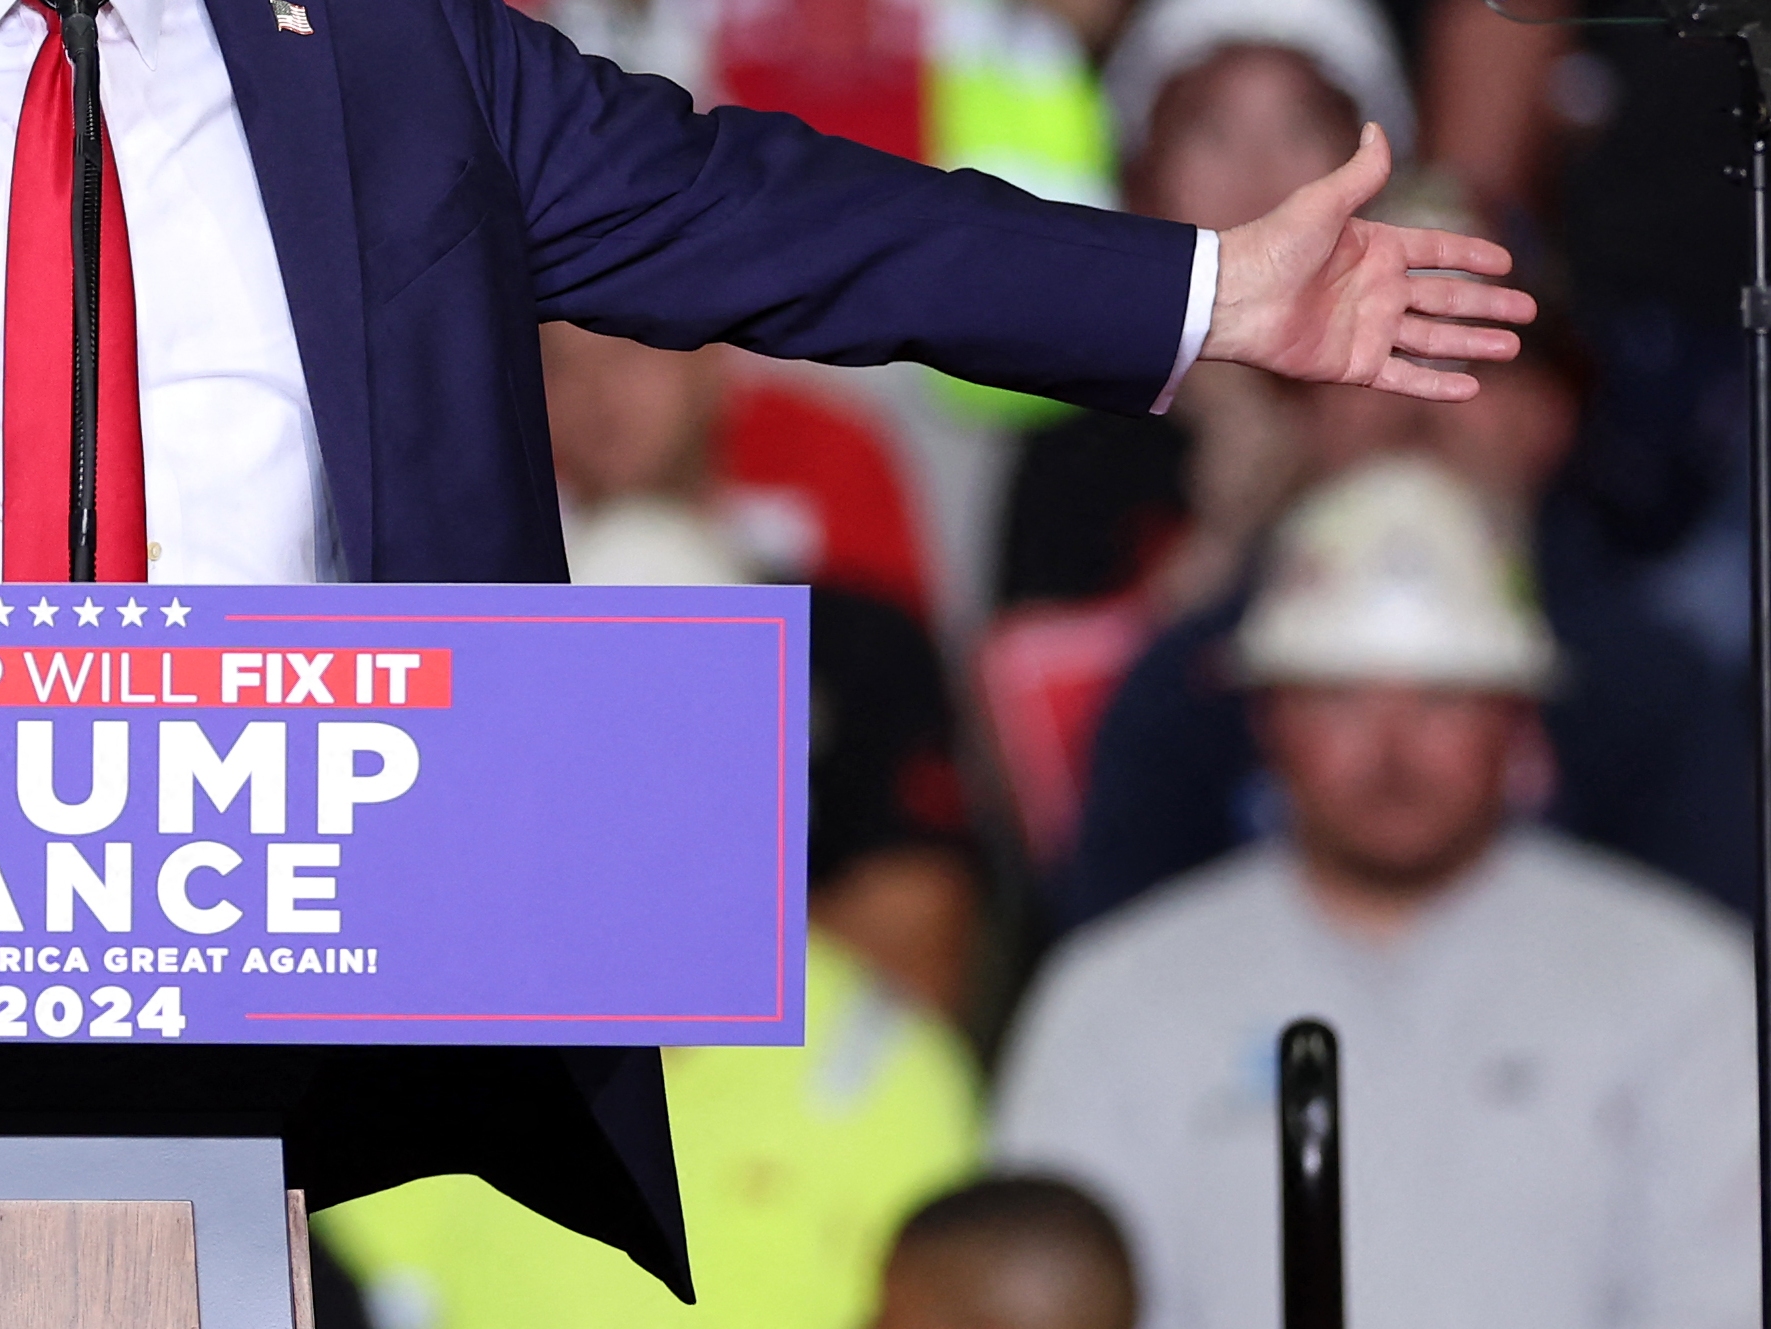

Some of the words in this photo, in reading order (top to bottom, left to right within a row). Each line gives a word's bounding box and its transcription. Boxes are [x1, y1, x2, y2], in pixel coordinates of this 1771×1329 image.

[22, 652, 198, 703] WILL
[221, 653, 335, 704] FIX
[356, 653, 420, 704] IT
[103, 946, 229, 973] GREAT
[241, 947, 378, 974] AGAIN!
